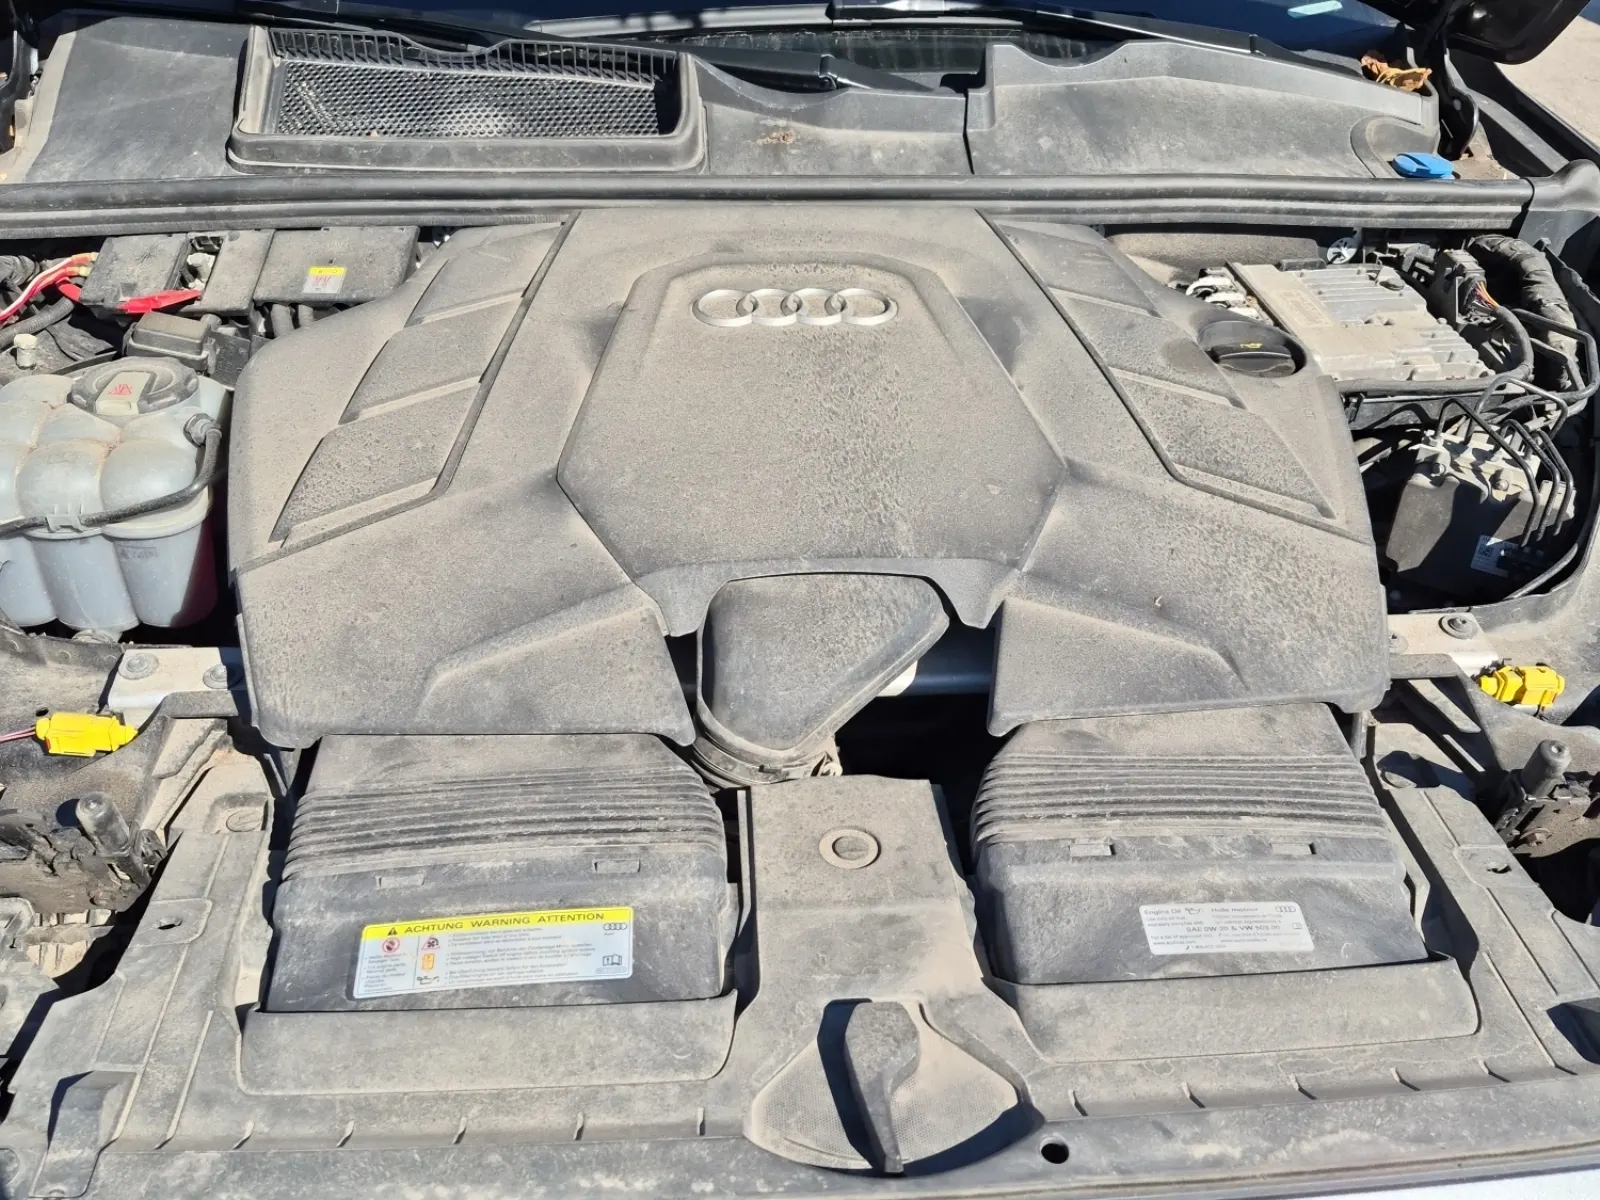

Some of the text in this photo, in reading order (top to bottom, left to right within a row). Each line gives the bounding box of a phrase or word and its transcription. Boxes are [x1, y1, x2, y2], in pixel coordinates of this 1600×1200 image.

[1144, 908, 1169, 916] Engine
[404, 912, 605, 935] ACHTUNG WARNING ATTENTION
